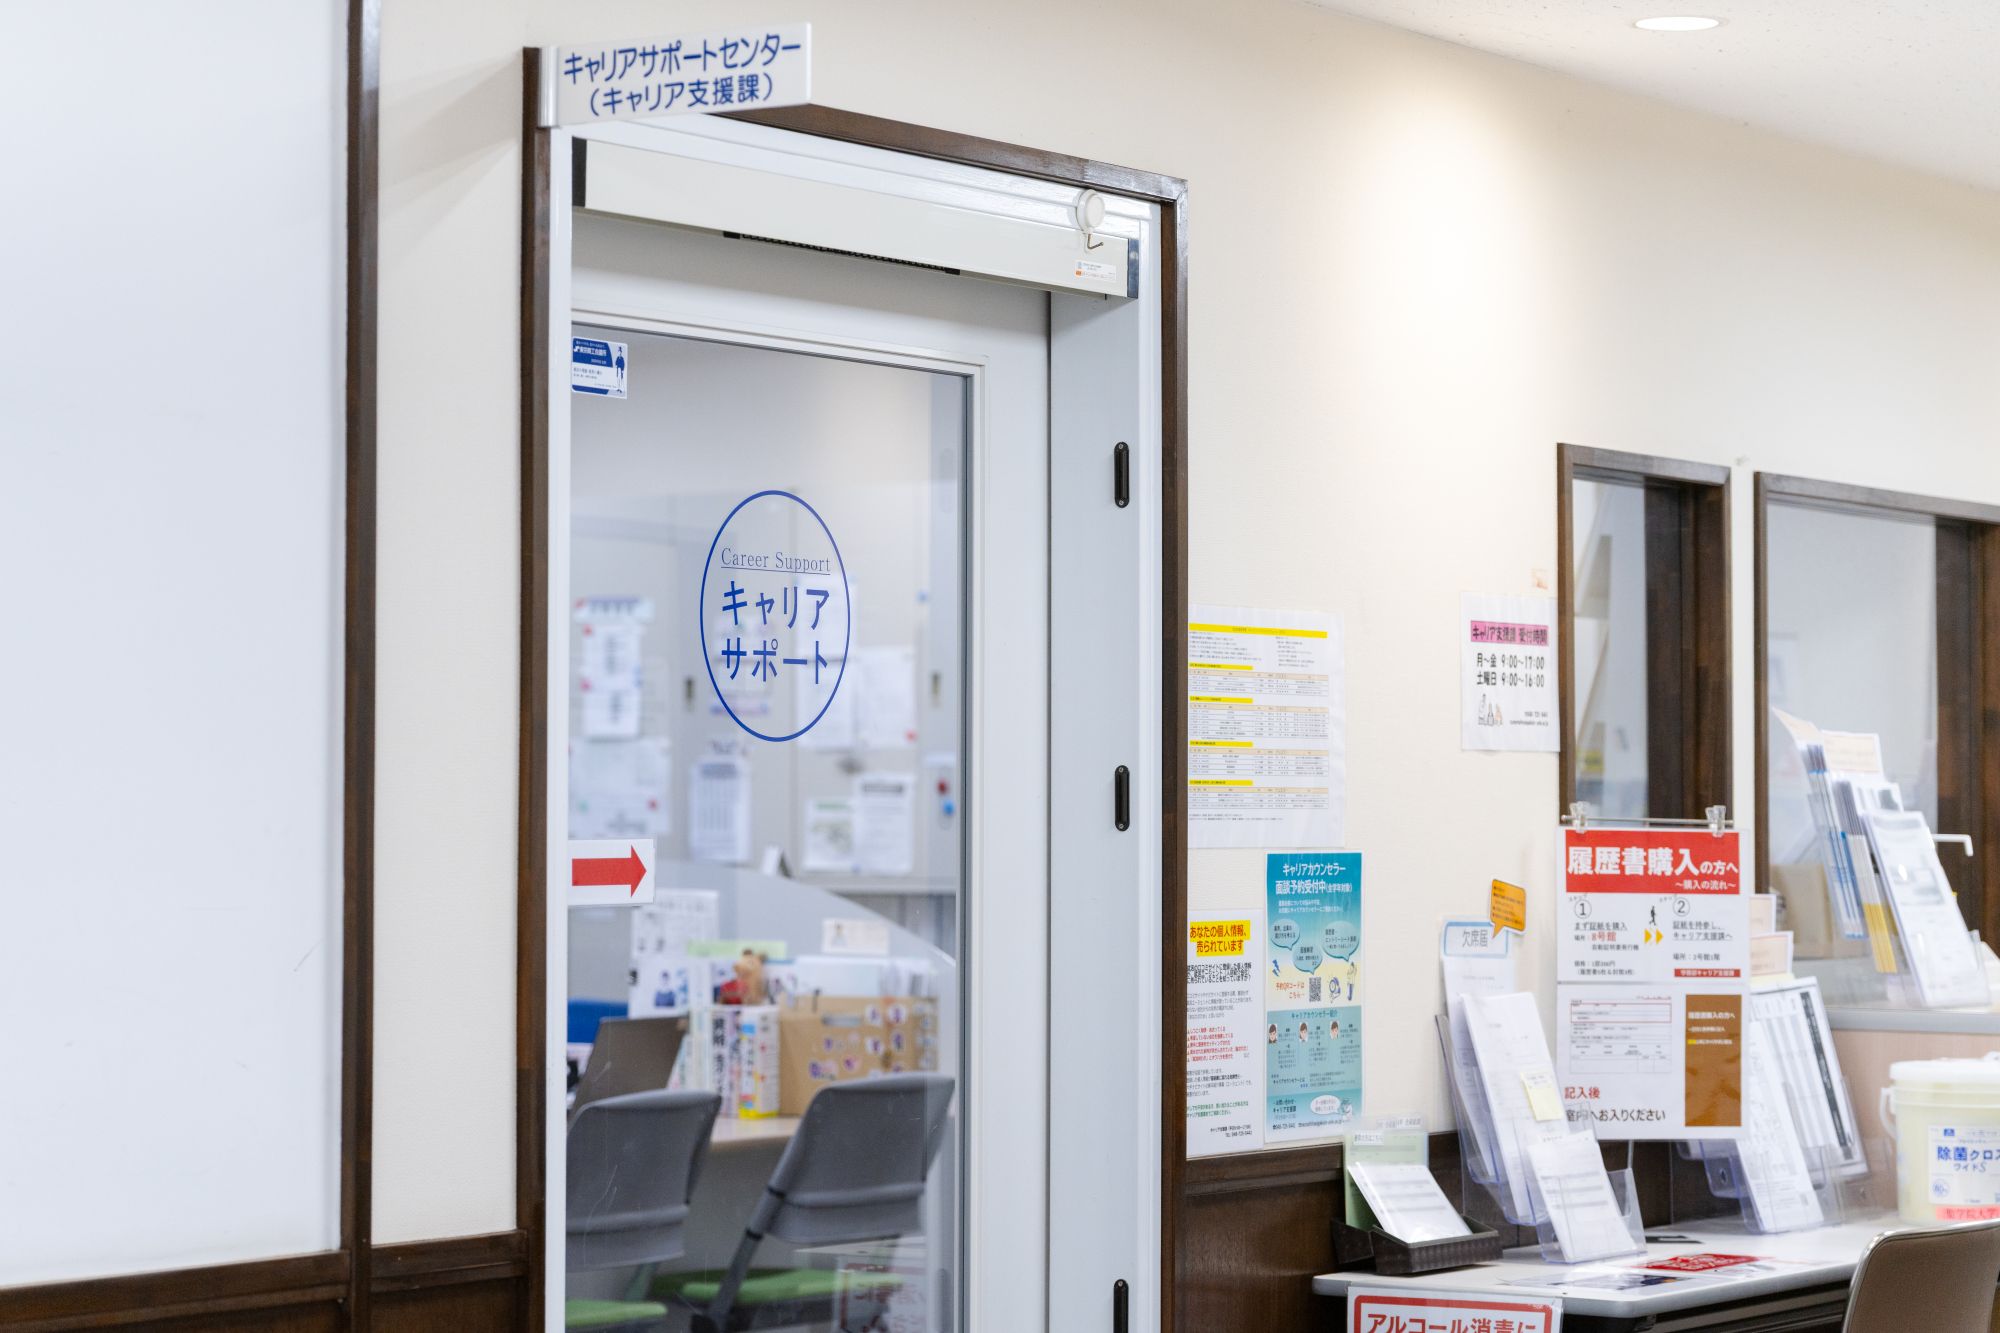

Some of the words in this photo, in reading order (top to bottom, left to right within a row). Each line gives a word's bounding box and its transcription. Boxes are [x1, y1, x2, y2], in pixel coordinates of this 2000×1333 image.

[564, 33, 801, 84] キャリアサポートセンター
[590, 73, 773, 116] （キャリア支援課）
[720, 547, 769, 568] Career
[775, 551, 831, 574] Support
[722, 580, 830, 630] キャリア
[1472, 625, 1517, 642] キャリア支援課
[1519, 627, 1548, 645] 受付時間
[721, 637, 828, 685] サポート
[1476, 671, 1497, 686] 土曜日
[1282, 863, 1346, 877] キャリアカウンセラー
[1568, 846, 1739, 877] 履歴書購入の方へ
[1189, 924, 1247, 938] あなたの個人情報、
[1462, 929, 1488, 947] 欠席届
[1196, 940, 1244, 953] 売られています
[1564, 1086, 1600, 1099] 記入後
